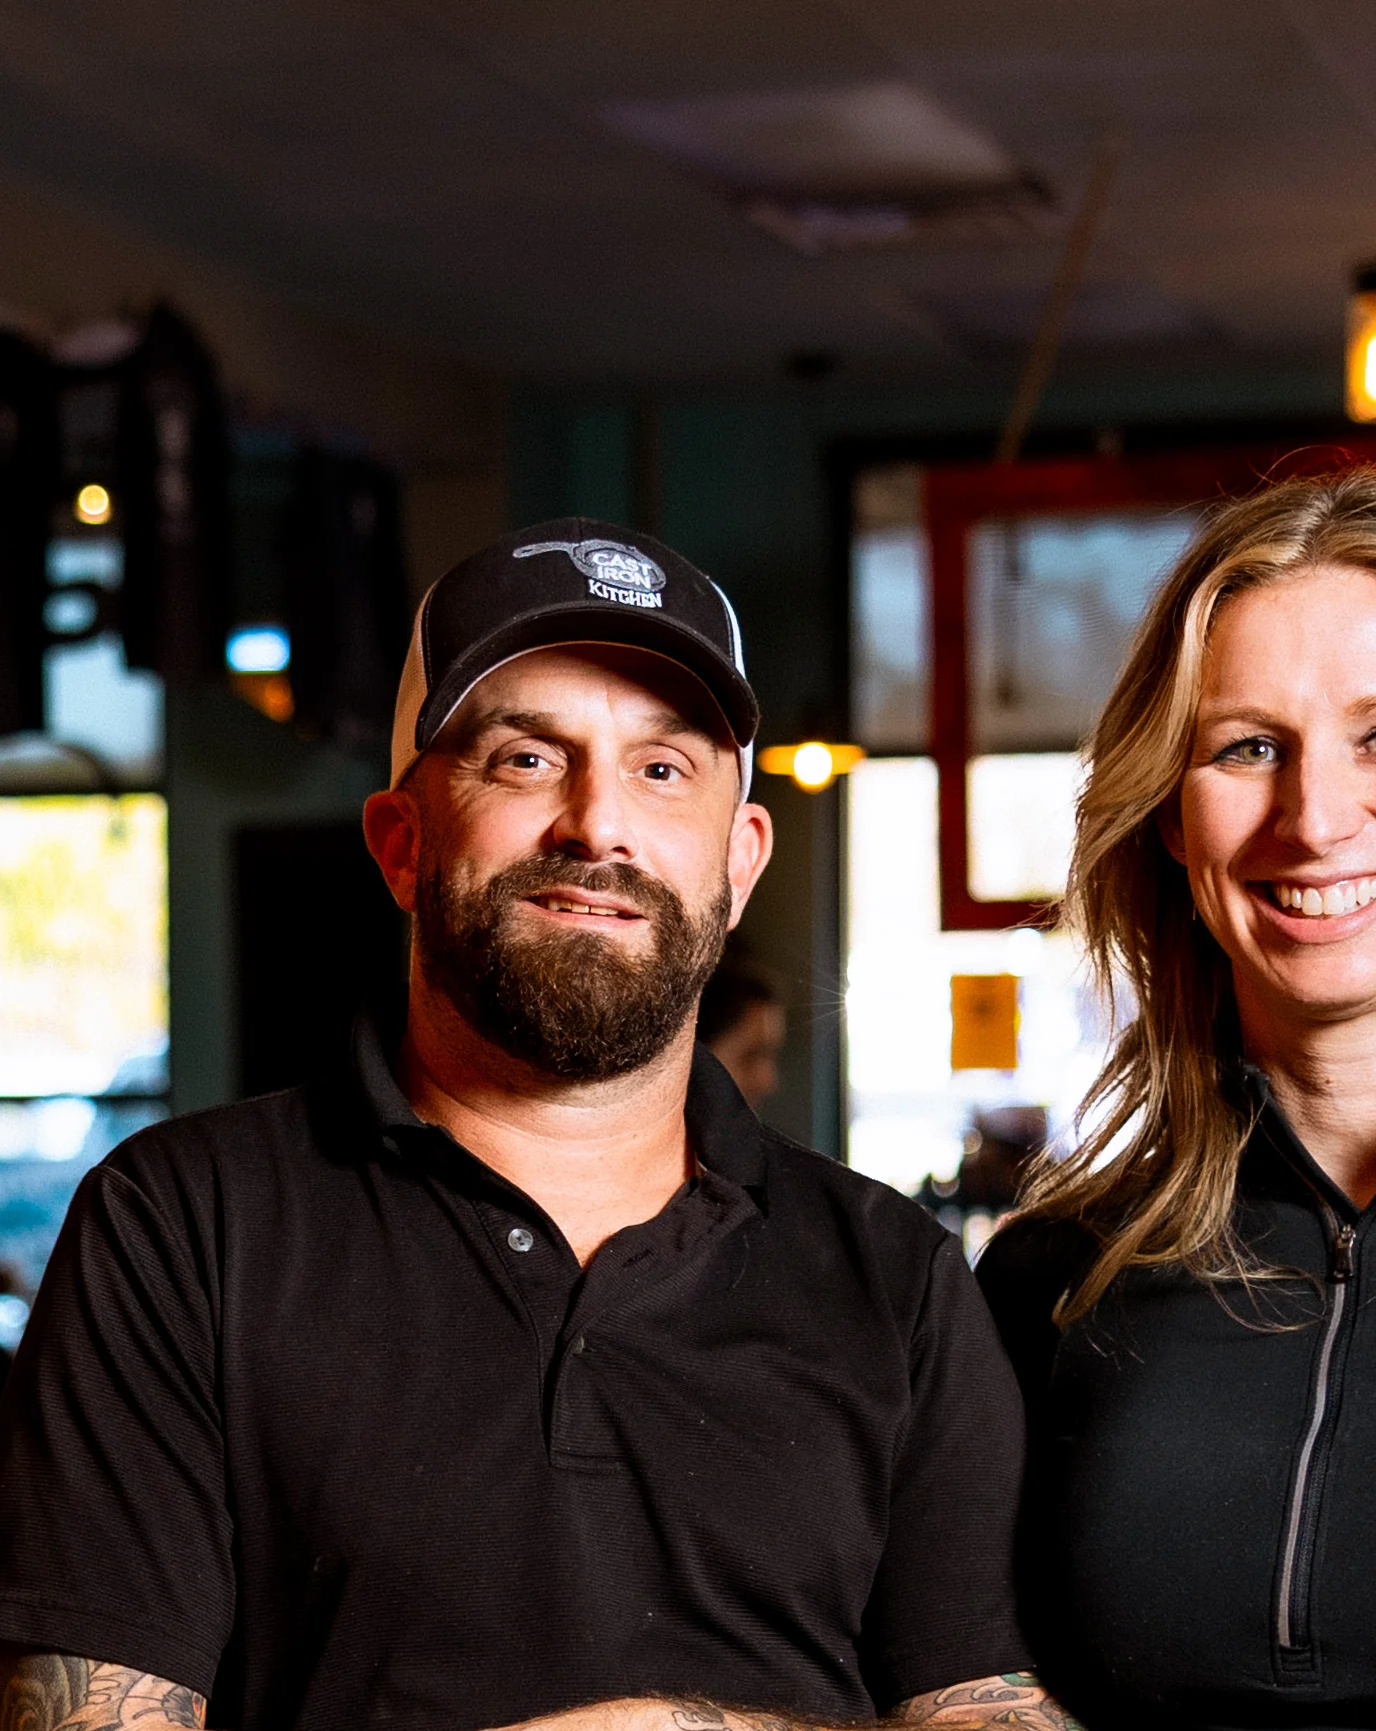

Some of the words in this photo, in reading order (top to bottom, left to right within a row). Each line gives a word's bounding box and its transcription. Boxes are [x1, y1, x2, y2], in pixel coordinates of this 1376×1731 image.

[592, 553, 651, 576] CAST
[597, 565, 651, 589] IRON
[588, 579, 662, 608] KITCHEN
